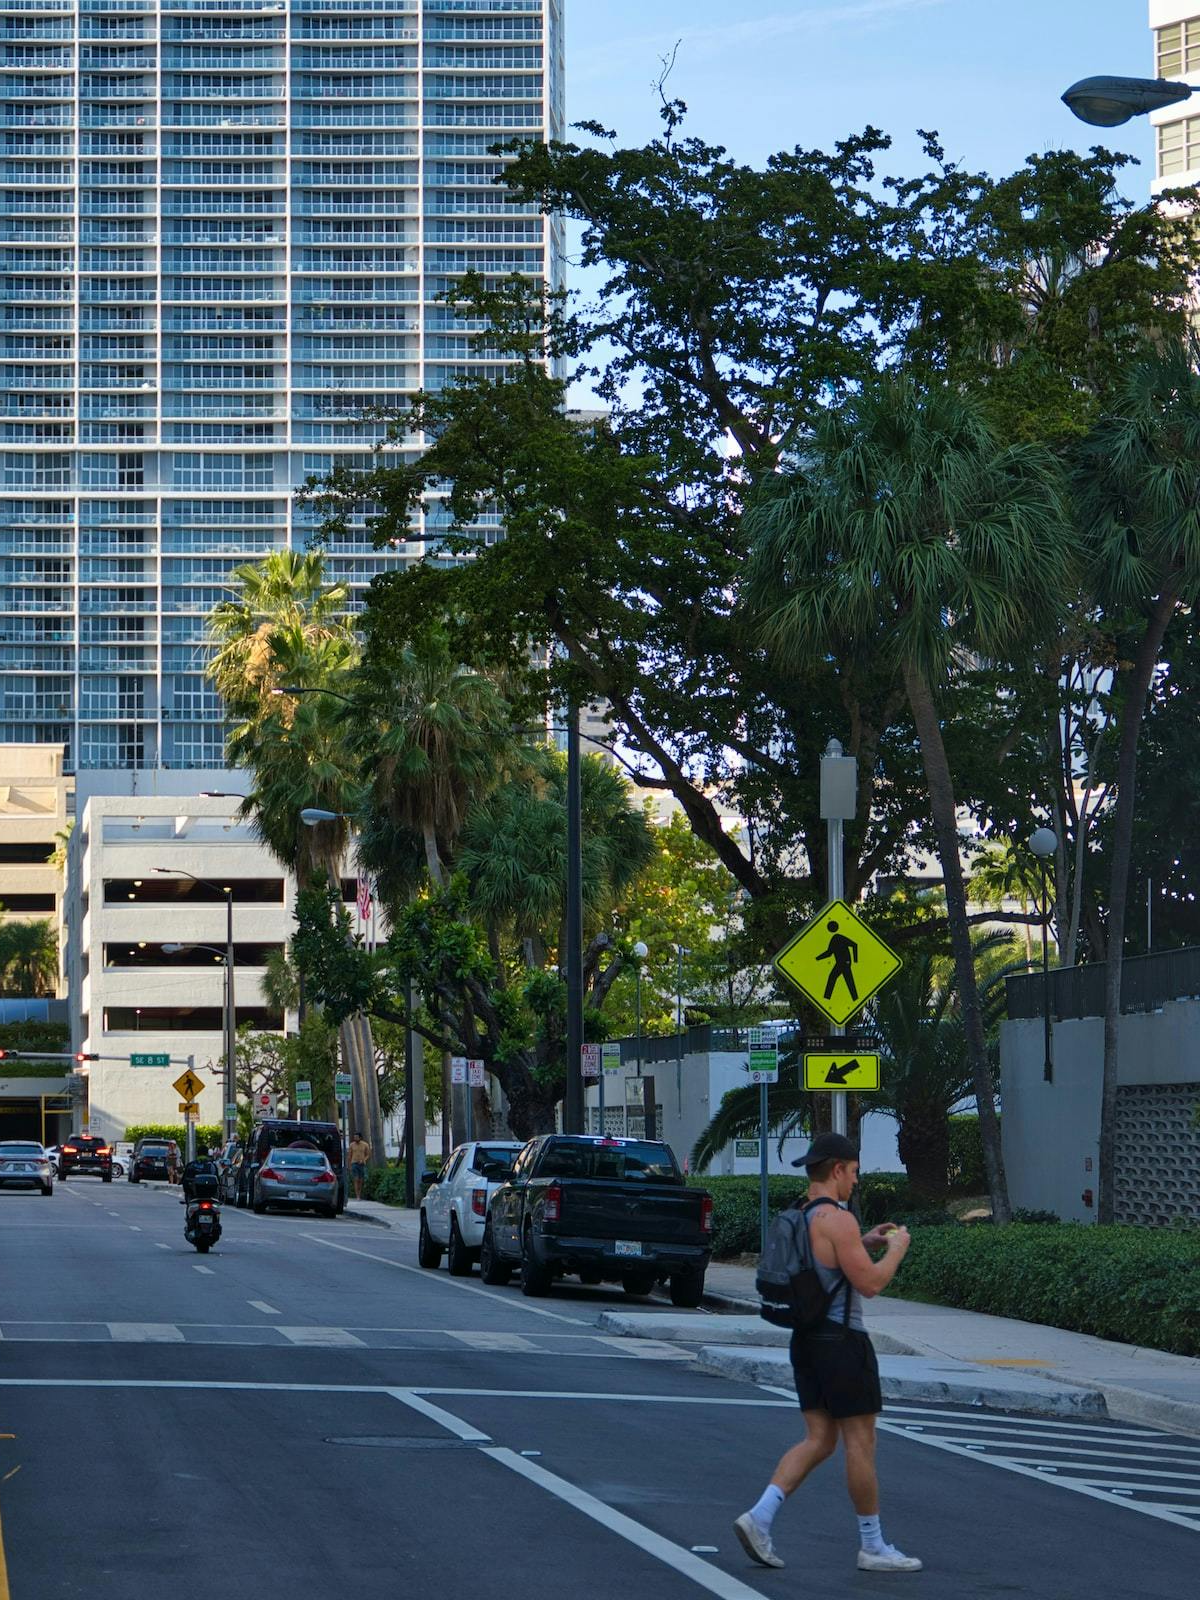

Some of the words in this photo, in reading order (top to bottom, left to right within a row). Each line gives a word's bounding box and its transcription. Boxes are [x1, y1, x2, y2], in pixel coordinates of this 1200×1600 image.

[135, 1056, 144, 1064] SE
[147, 1056, 154, 1064] 8
[156, 1056, 165, 1064] ST
